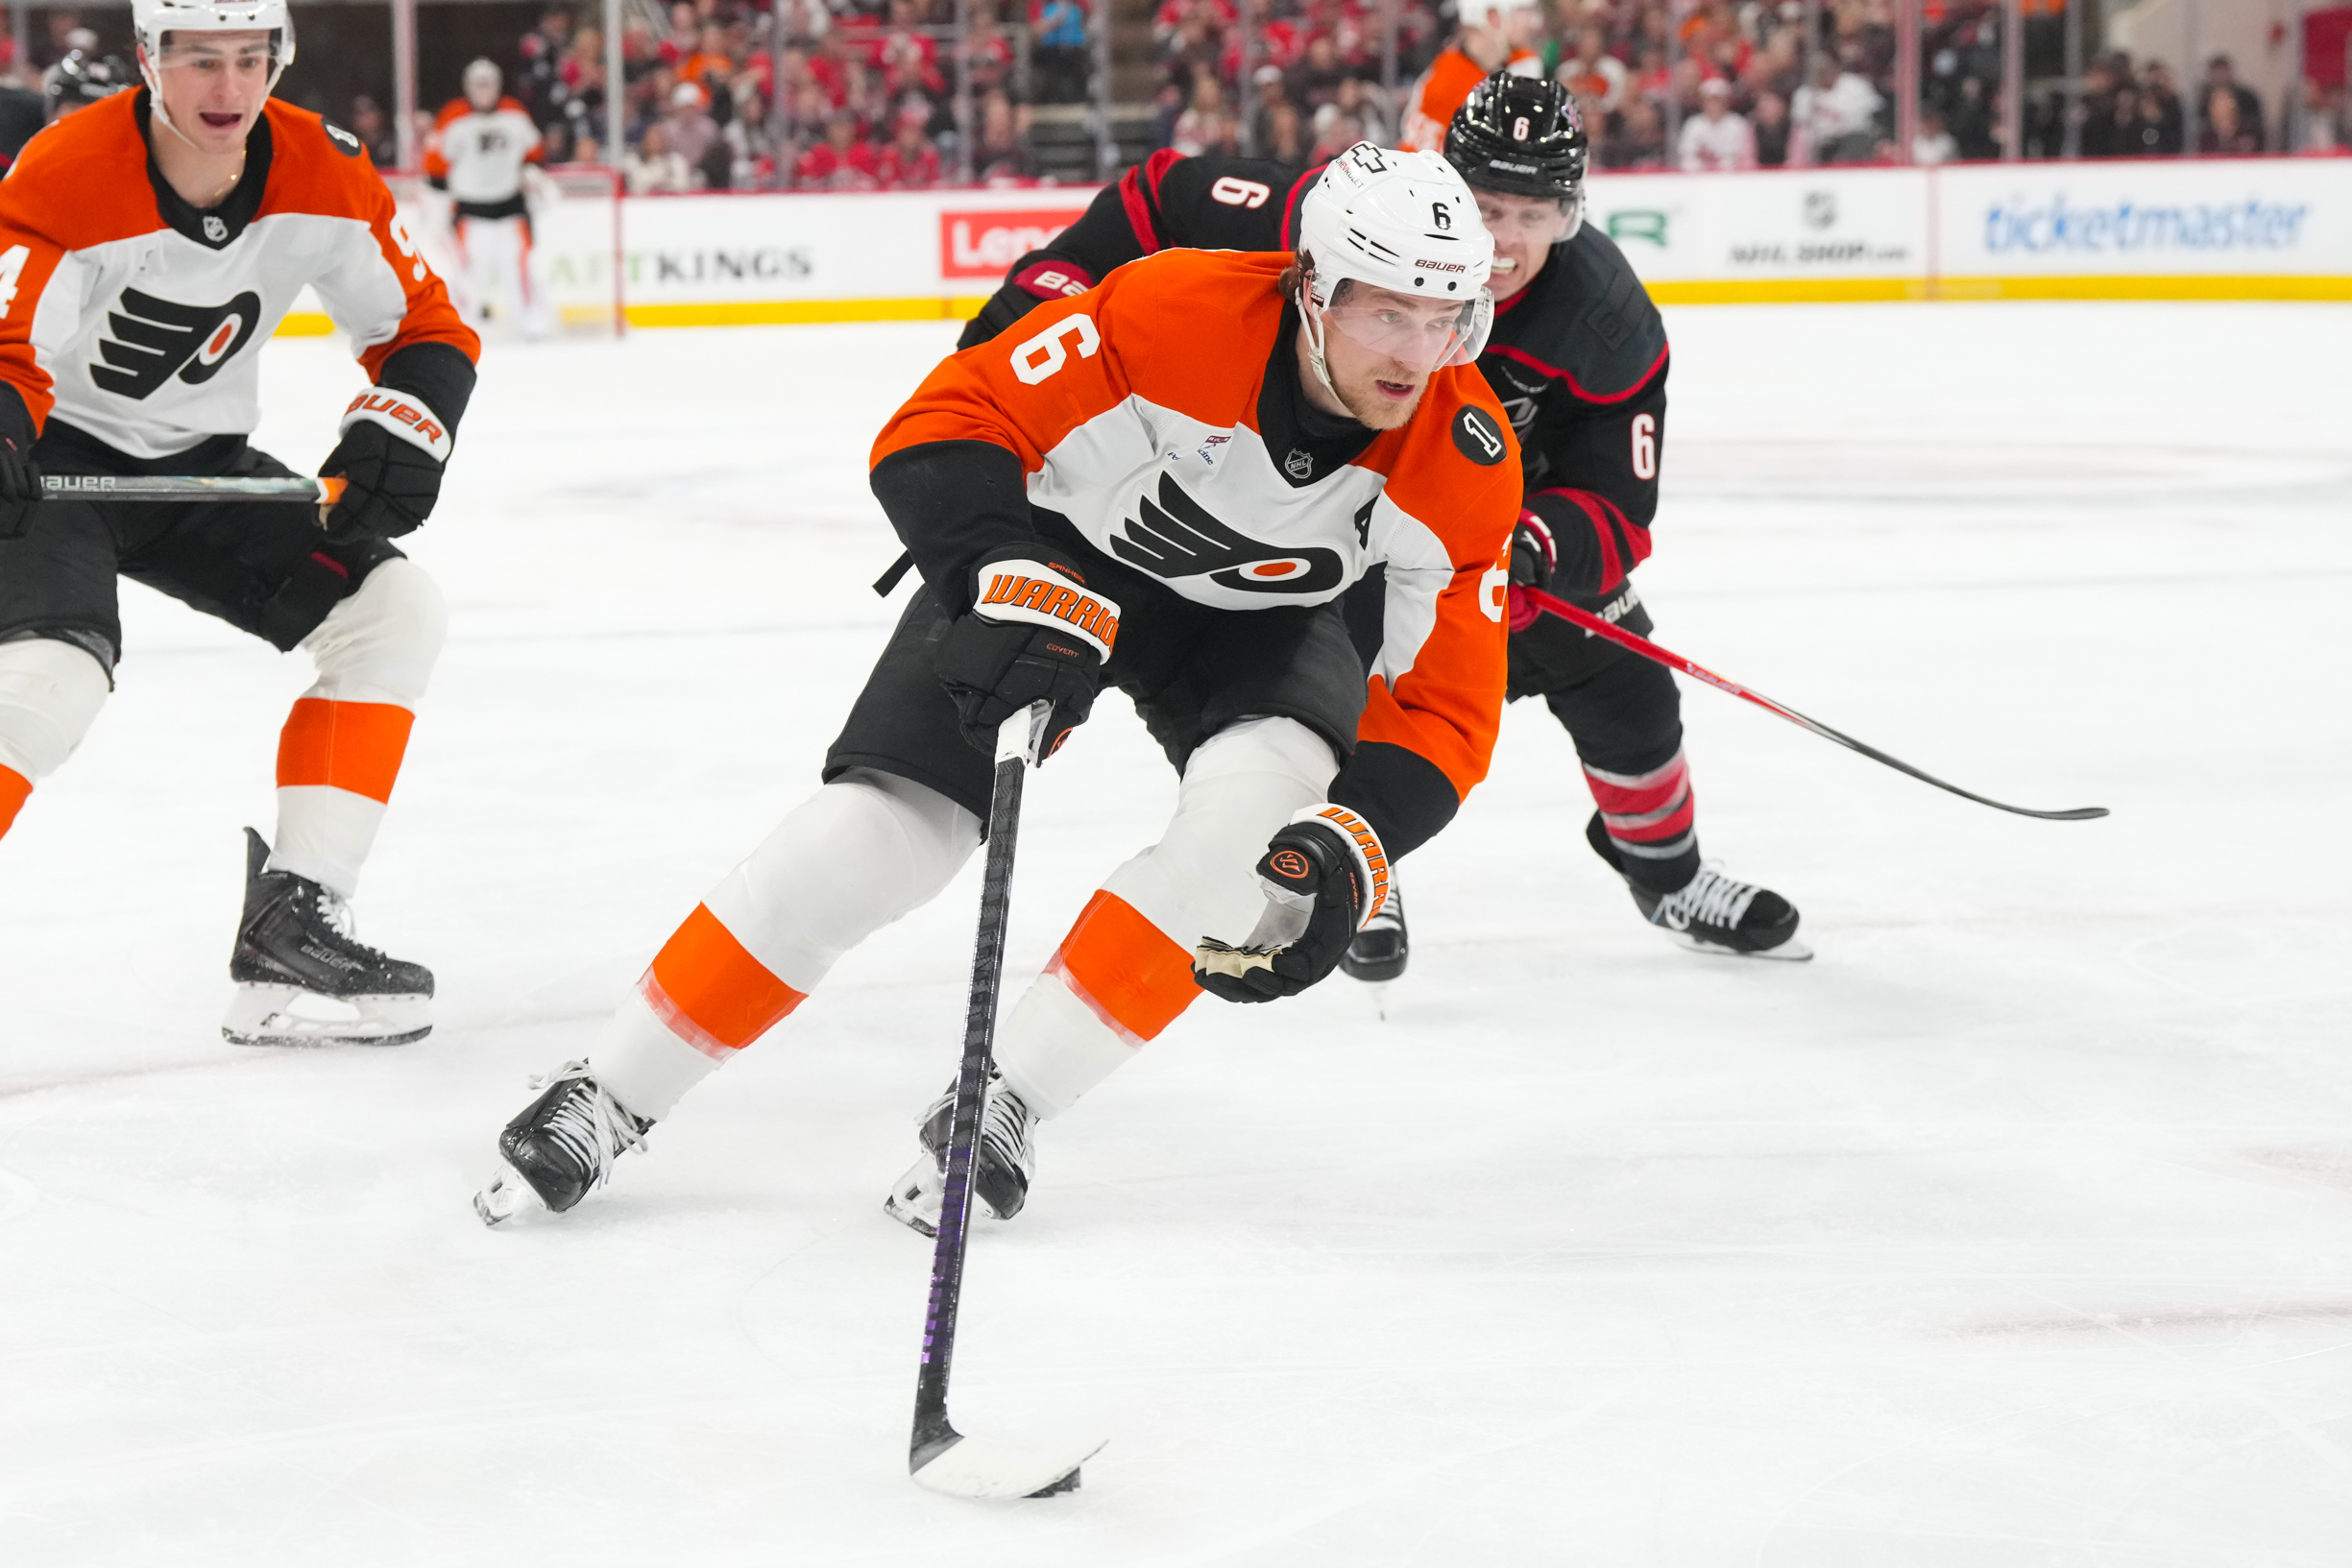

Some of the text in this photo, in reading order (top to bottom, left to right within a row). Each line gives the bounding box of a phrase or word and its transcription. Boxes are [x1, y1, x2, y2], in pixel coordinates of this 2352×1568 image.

[1513, 116, 1530, 141] 6
[1211, 176, 1271, 208] 6
[1432, 202, 1451, 230] 6
[1984, 195, 2310, 251] ticketmaster
[952, 221, 1071, 269] Len
[1009, 313, 1101, 385] 6
[1463, 411, 1502, 458] 1
[1632, 413, 1656, 480] 6
[40, 475, 115, 491] AUER
[1290, 459, 1307, 470] NHL
[982, 574, 1120, 657] WARRIO
[1046, 642, 1079, 658] COVERT
